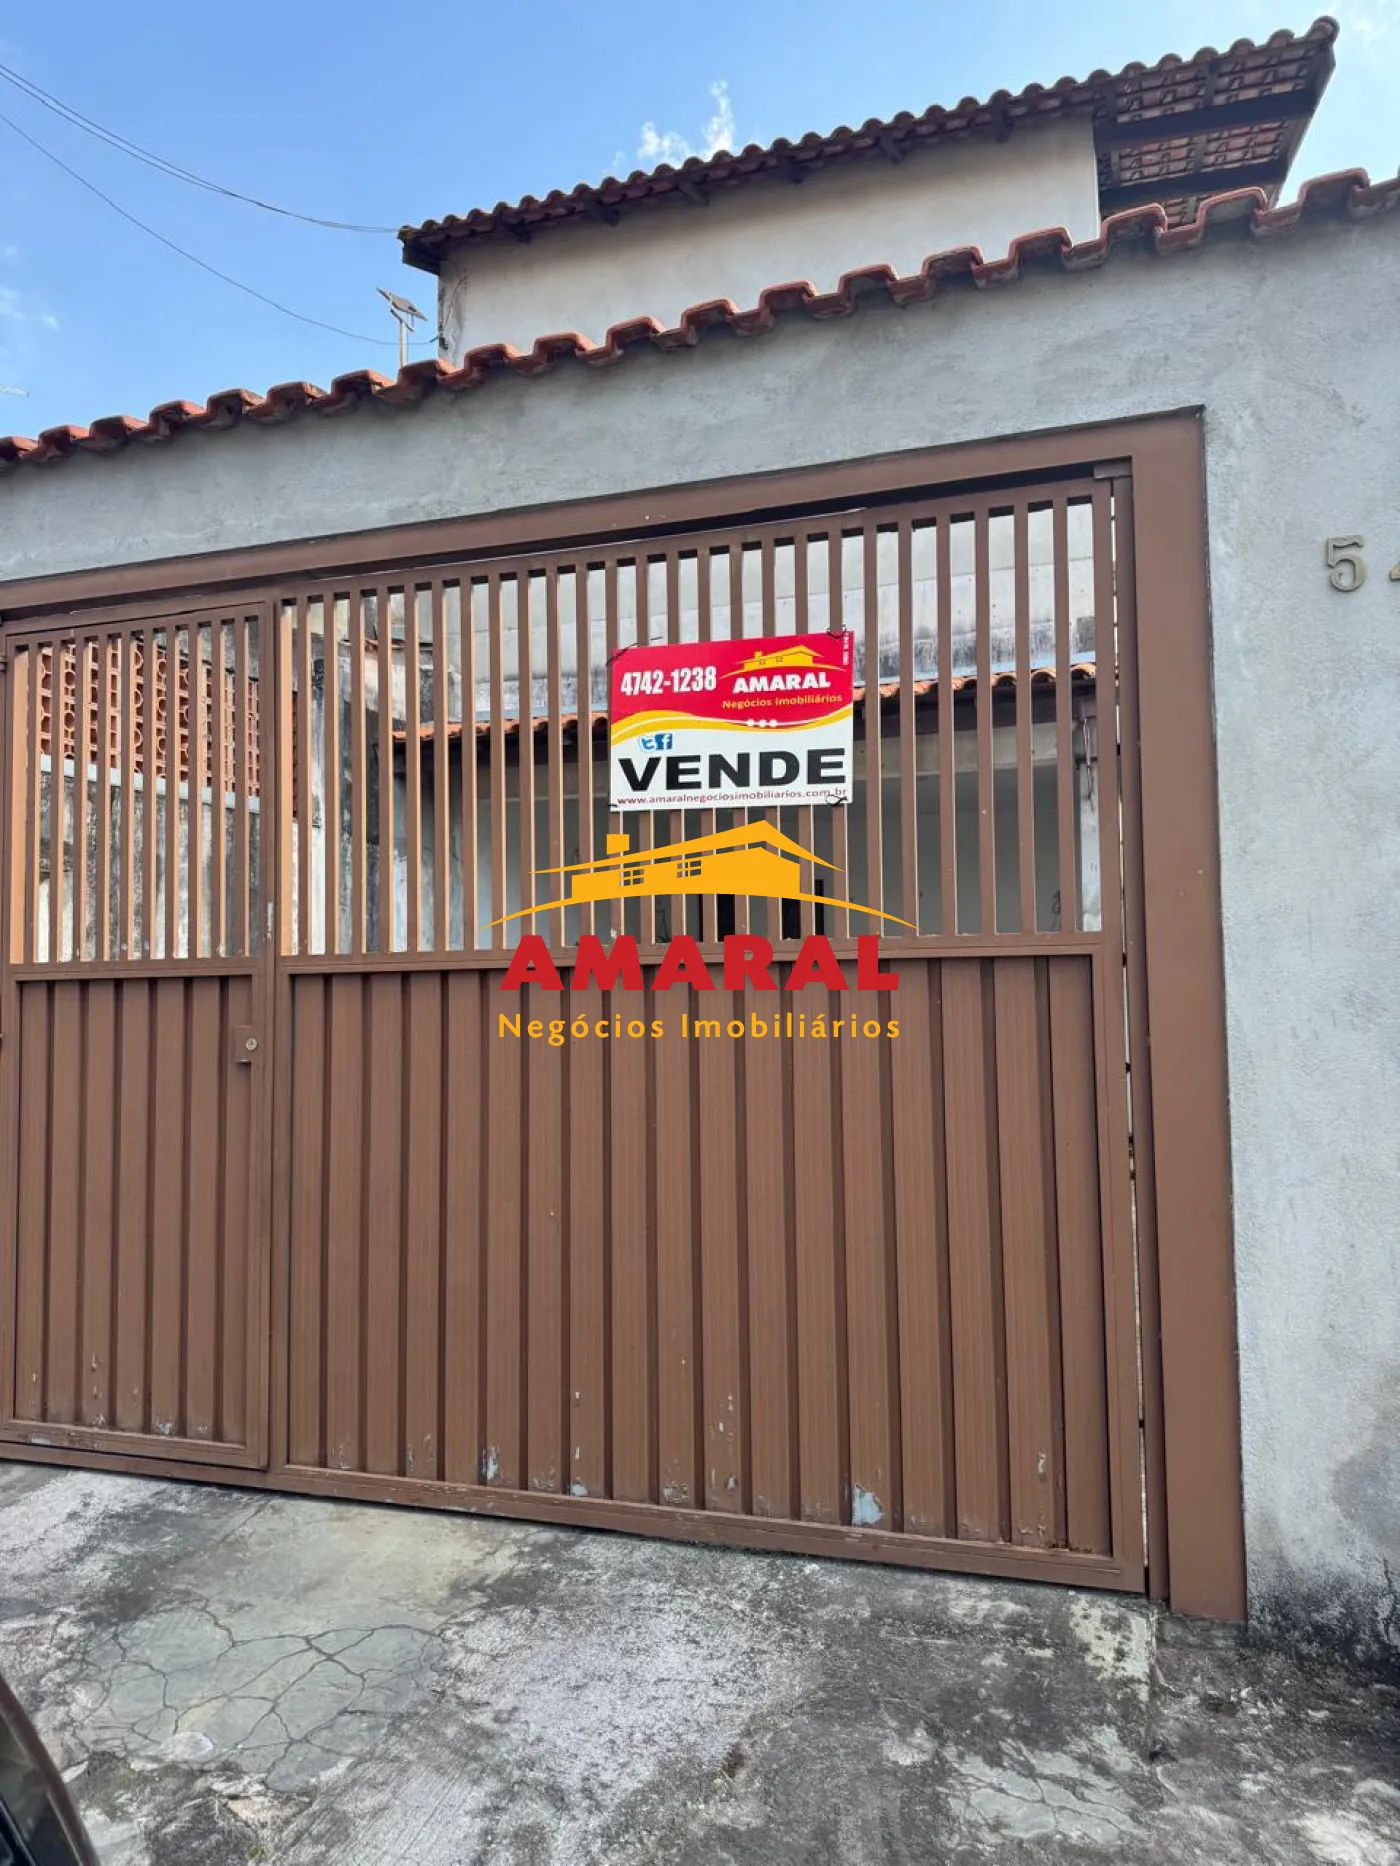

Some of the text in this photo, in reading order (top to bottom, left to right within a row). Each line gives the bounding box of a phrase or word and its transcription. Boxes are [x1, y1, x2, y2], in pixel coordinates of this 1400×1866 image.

[620, 666, 717, 696] 4742-1238
[733, 671, 831, 694] AMARAL
[722, 698, 772, 709] Negócios
[618, 747, 846, 792] VENDE
[617, 787, 847, 804] www.amaralnegociosimobiliarios.com.br
